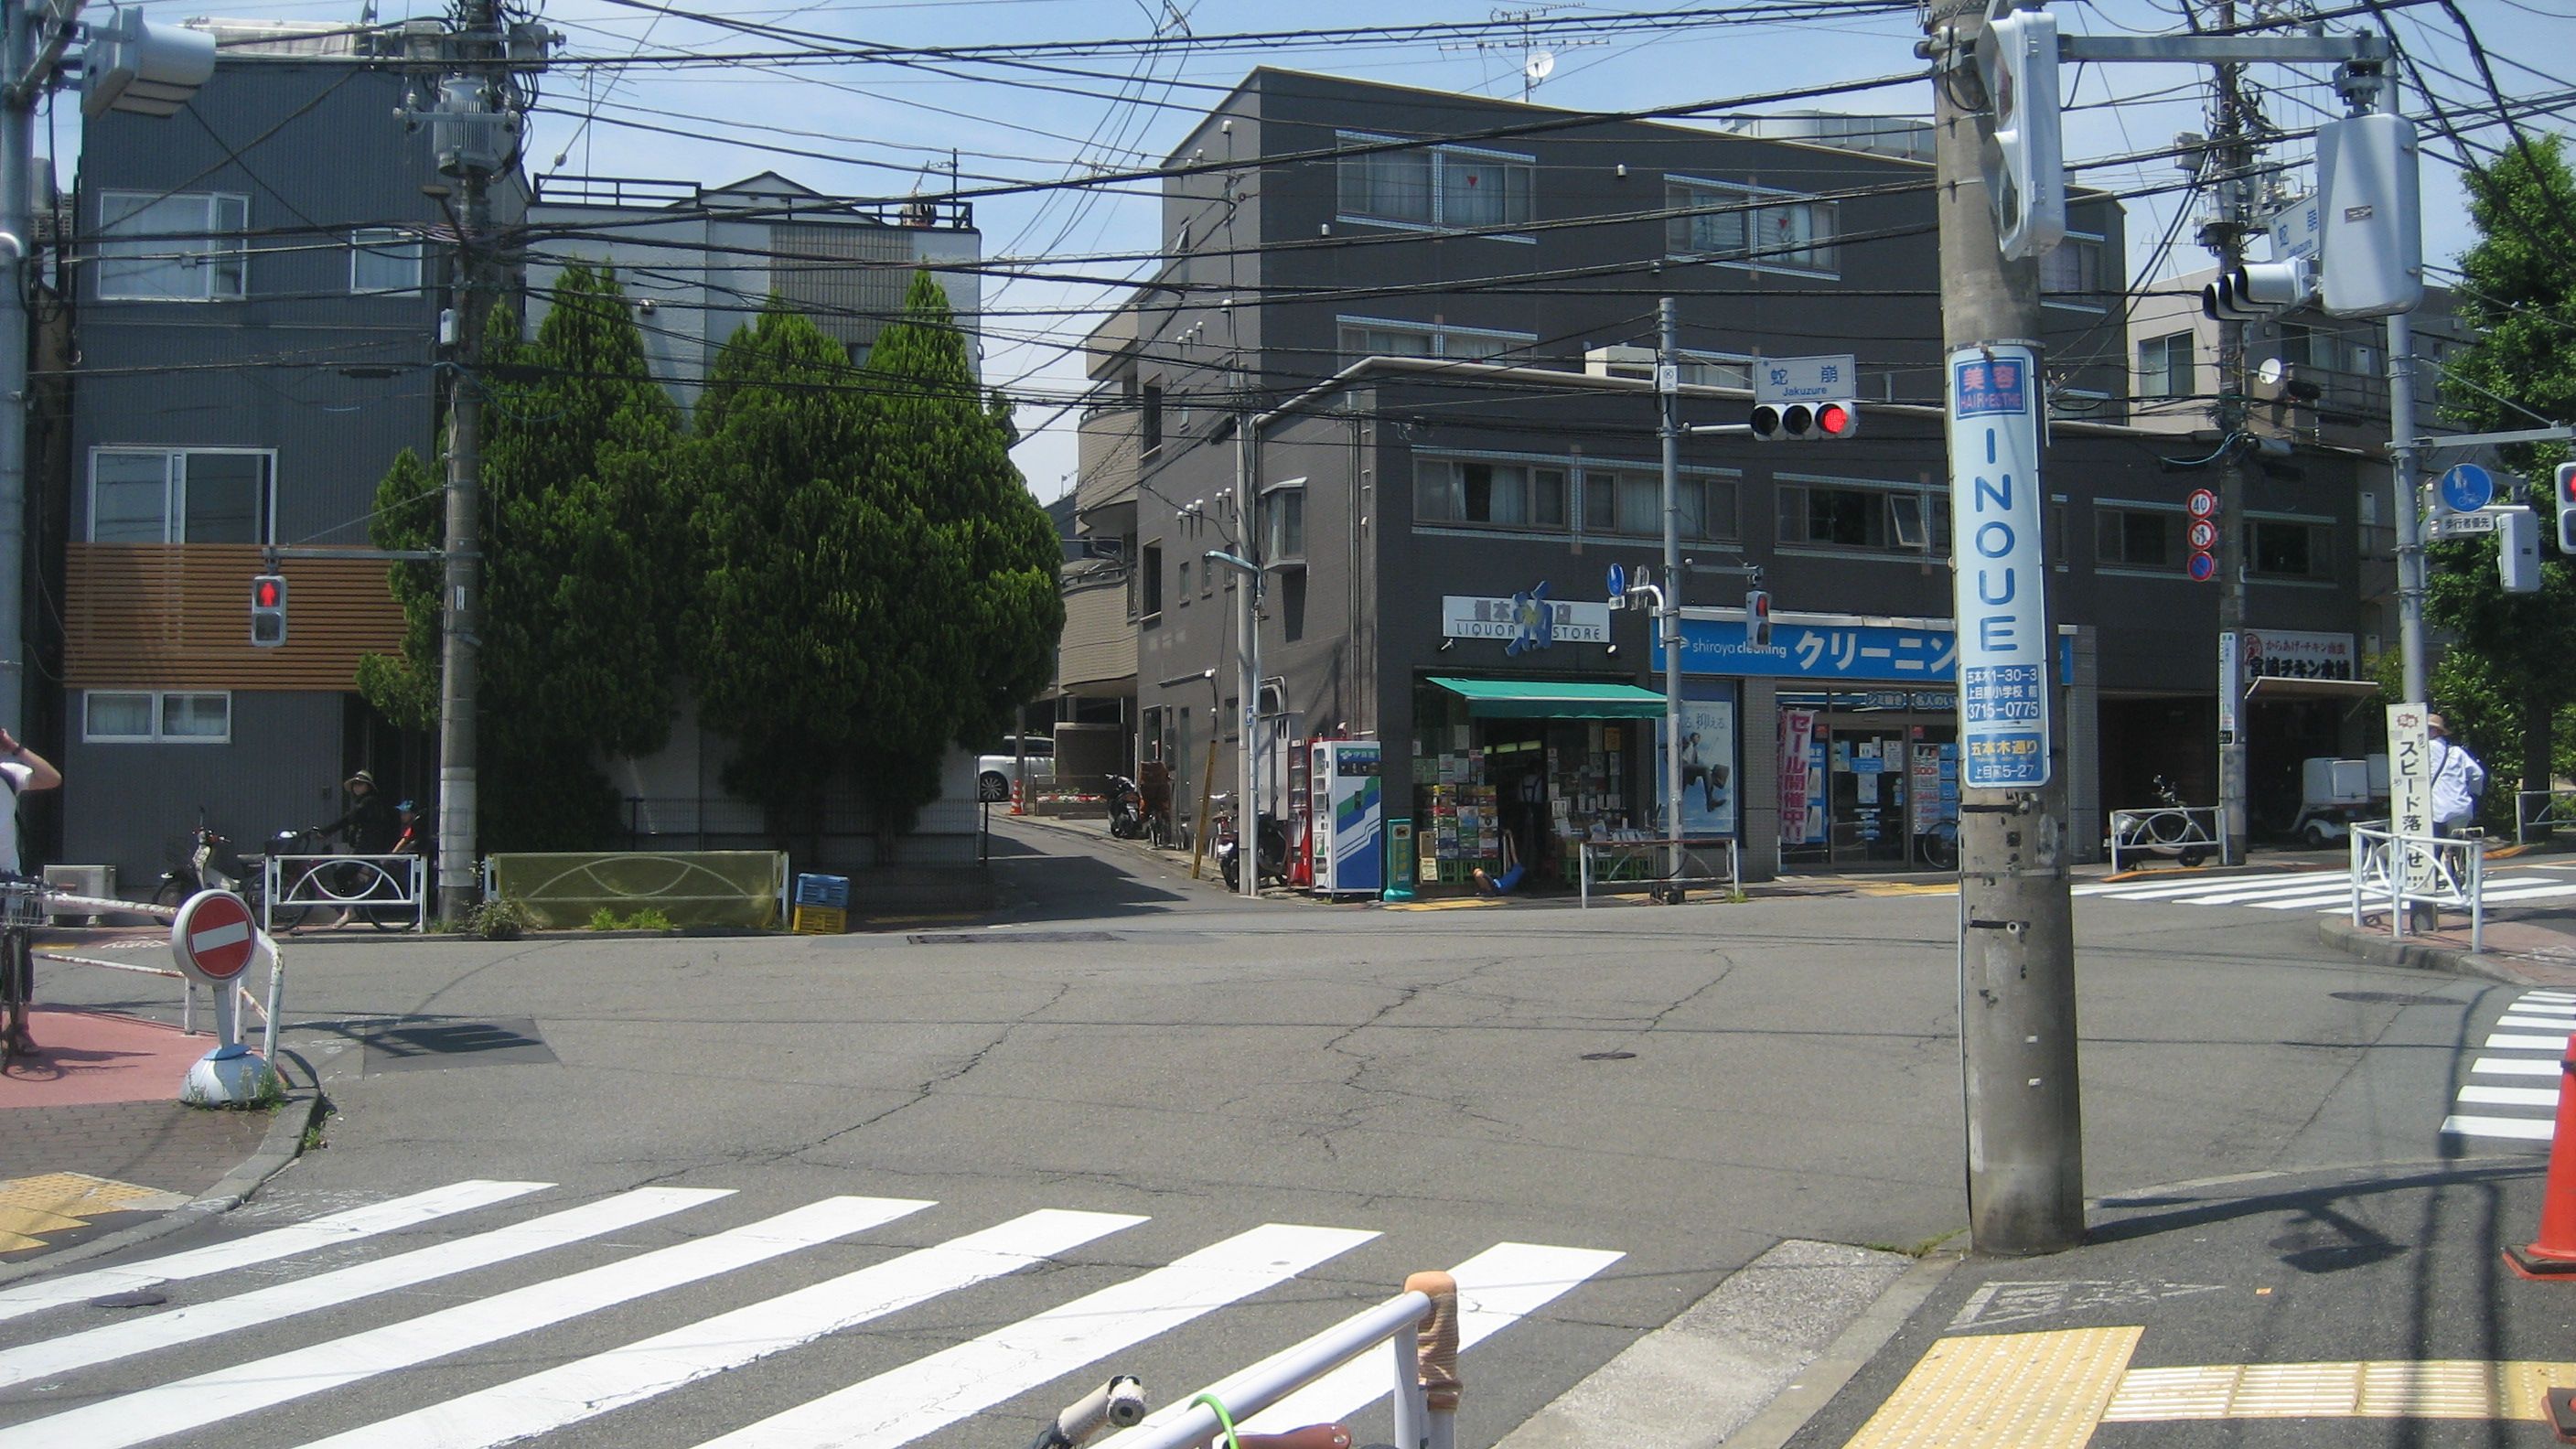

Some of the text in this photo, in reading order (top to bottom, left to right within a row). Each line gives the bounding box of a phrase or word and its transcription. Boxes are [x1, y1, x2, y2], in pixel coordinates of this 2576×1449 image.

[1770, 365, 1838, 386] 蛇崩
[1963, 364, 2016, 392] 美容
[1782, 386, 1828, 396] Jakuzure
[2193, 497, 2207, 511] 40
[1975, 428, 2019, 651] INOUE
[1457, 623, 1600, 640] LIQUOR STORE
[1692, 639, 1736, 657] shiroya
[1968, 702, 2039, 719] 3715-0775
[1970, 740, 2038, 757] 五本木通り
[2399, 741, 2424, 868] スピード落せ
